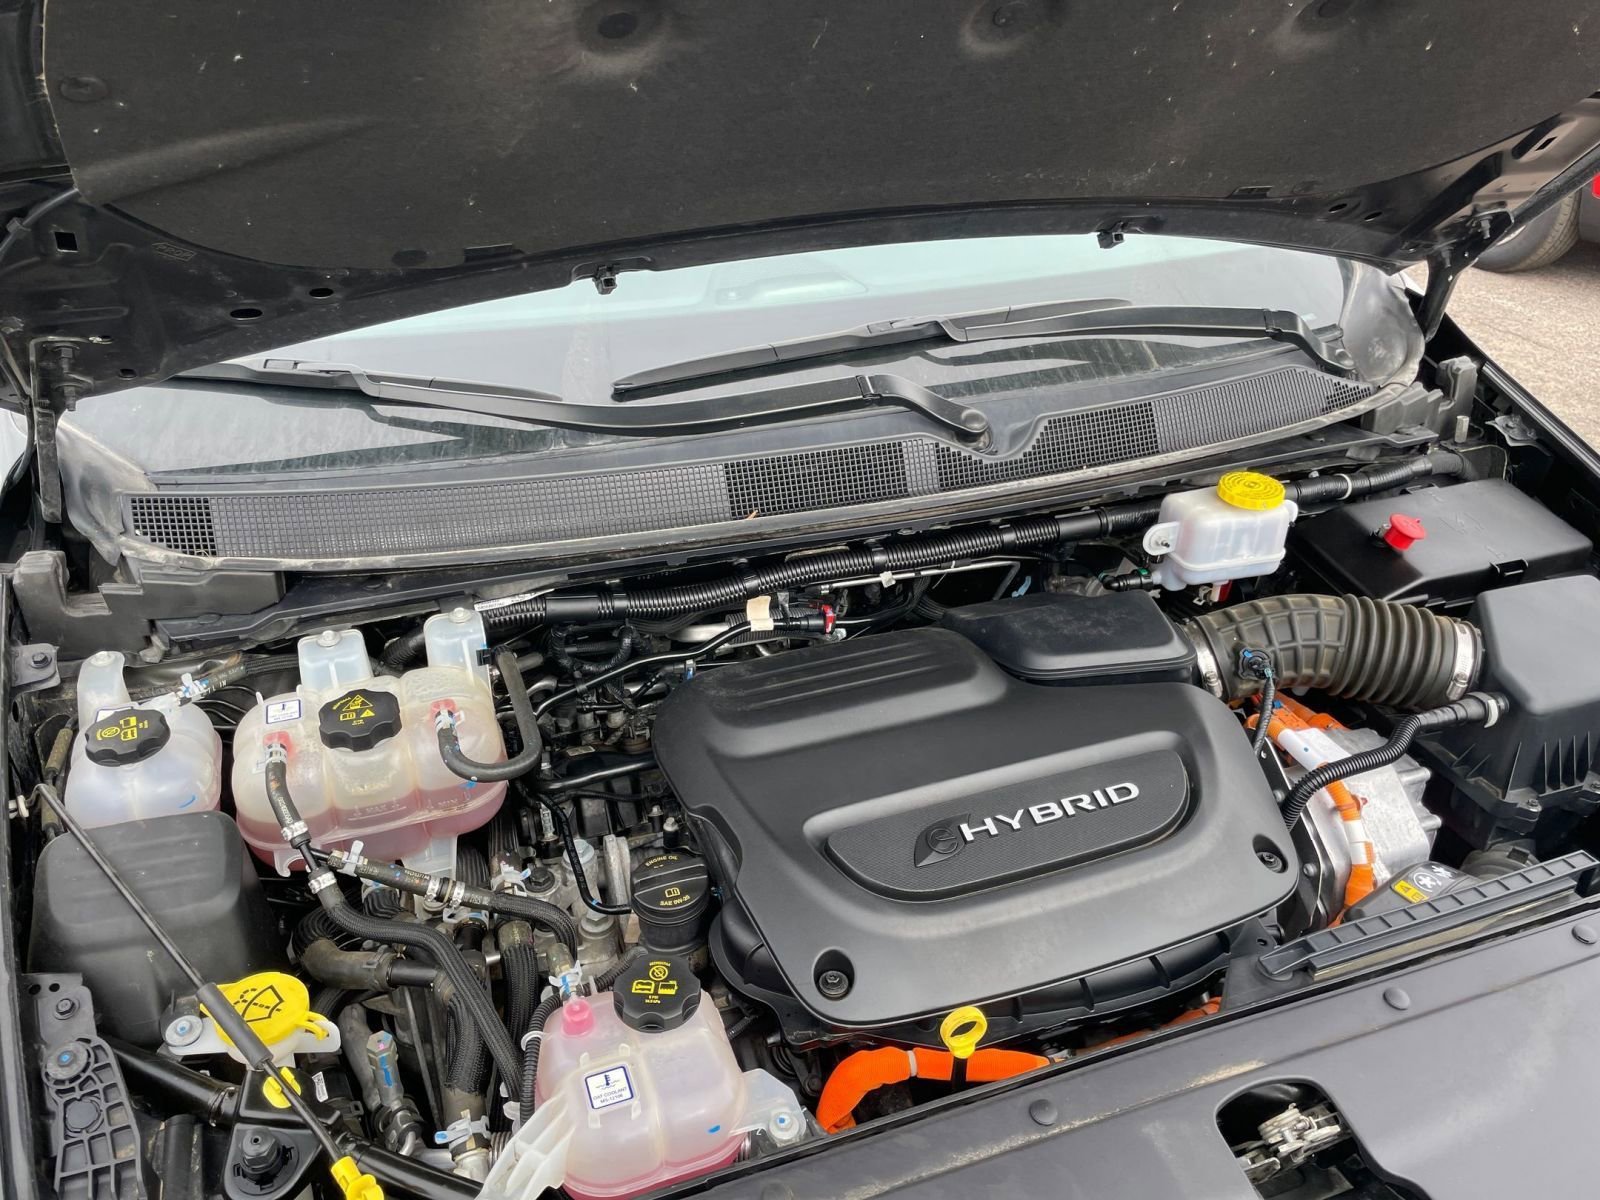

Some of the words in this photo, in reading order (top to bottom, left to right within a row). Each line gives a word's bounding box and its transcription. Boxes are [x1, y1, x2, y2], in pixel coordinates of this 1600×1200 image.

[959, 782, 1140, 842] HYBRID
[645, 855, 667, 867] ENGINE
[603, 1086, 627, 1097] COOLANT
